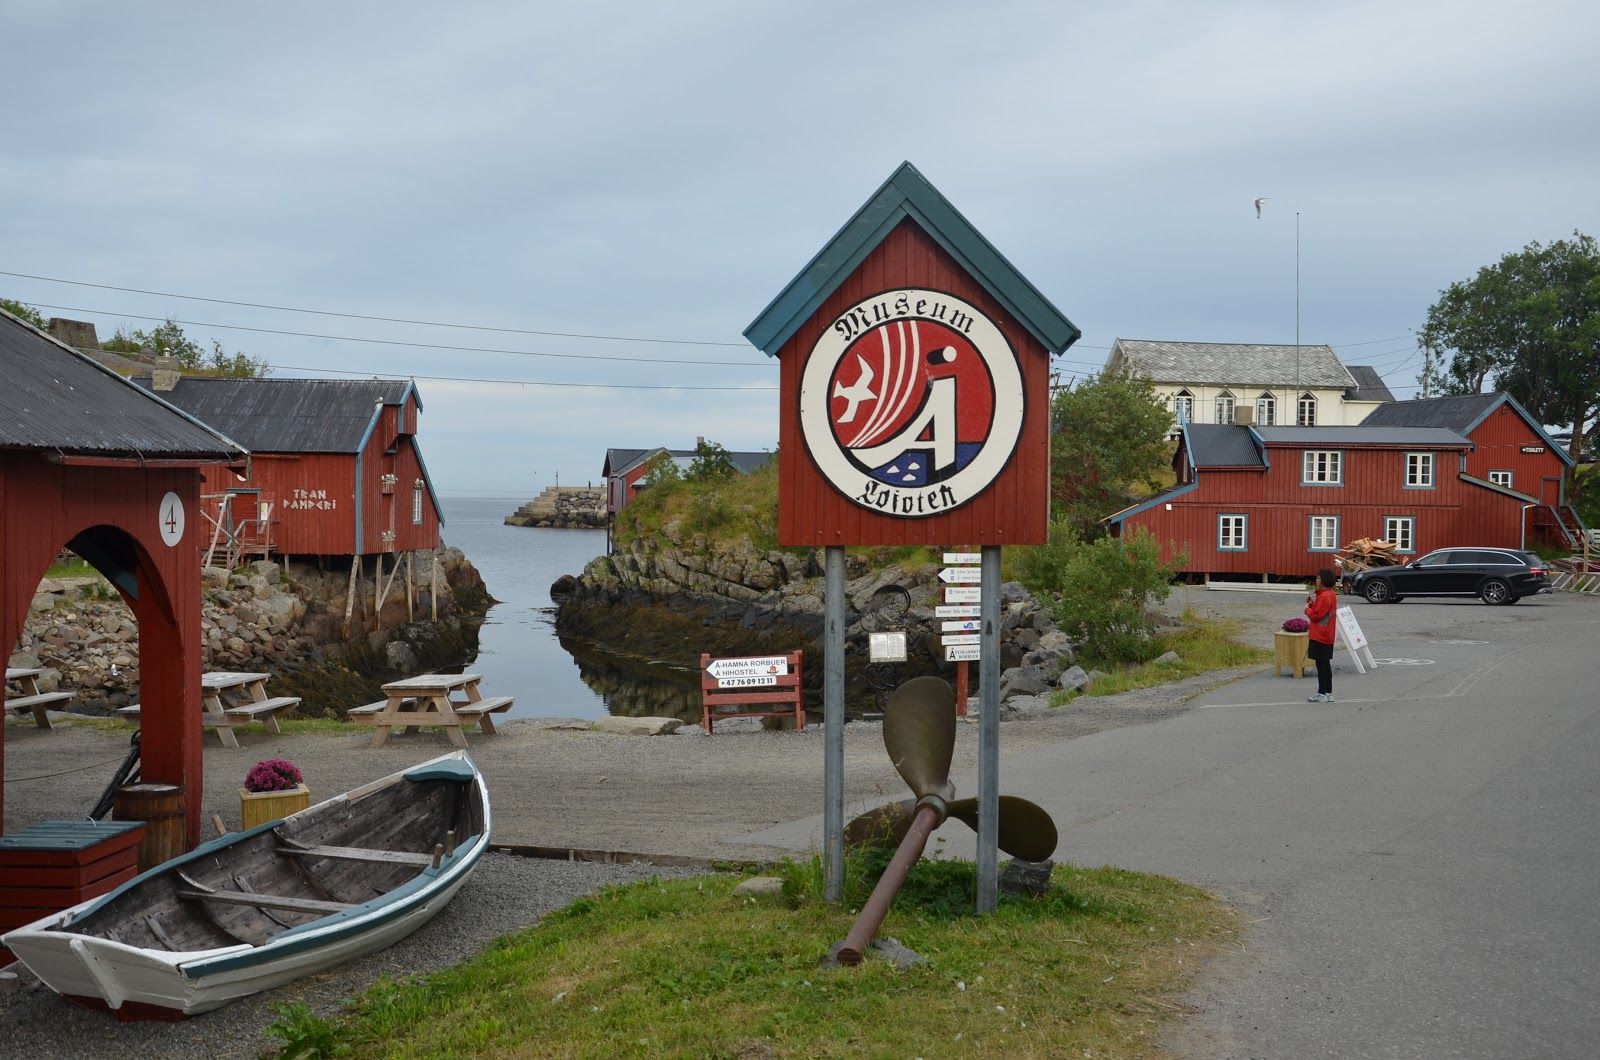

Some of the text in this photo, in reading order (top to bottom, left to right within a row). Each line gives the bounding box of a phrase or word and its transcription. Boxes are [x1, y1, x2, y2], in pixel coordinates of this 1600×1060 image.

[834, 292, 975, 341] Museum
[293, 489, 326, 499] TRAN
[164, 503, 177, 534] 4
[750, 659, 786, 667] RORBUER
